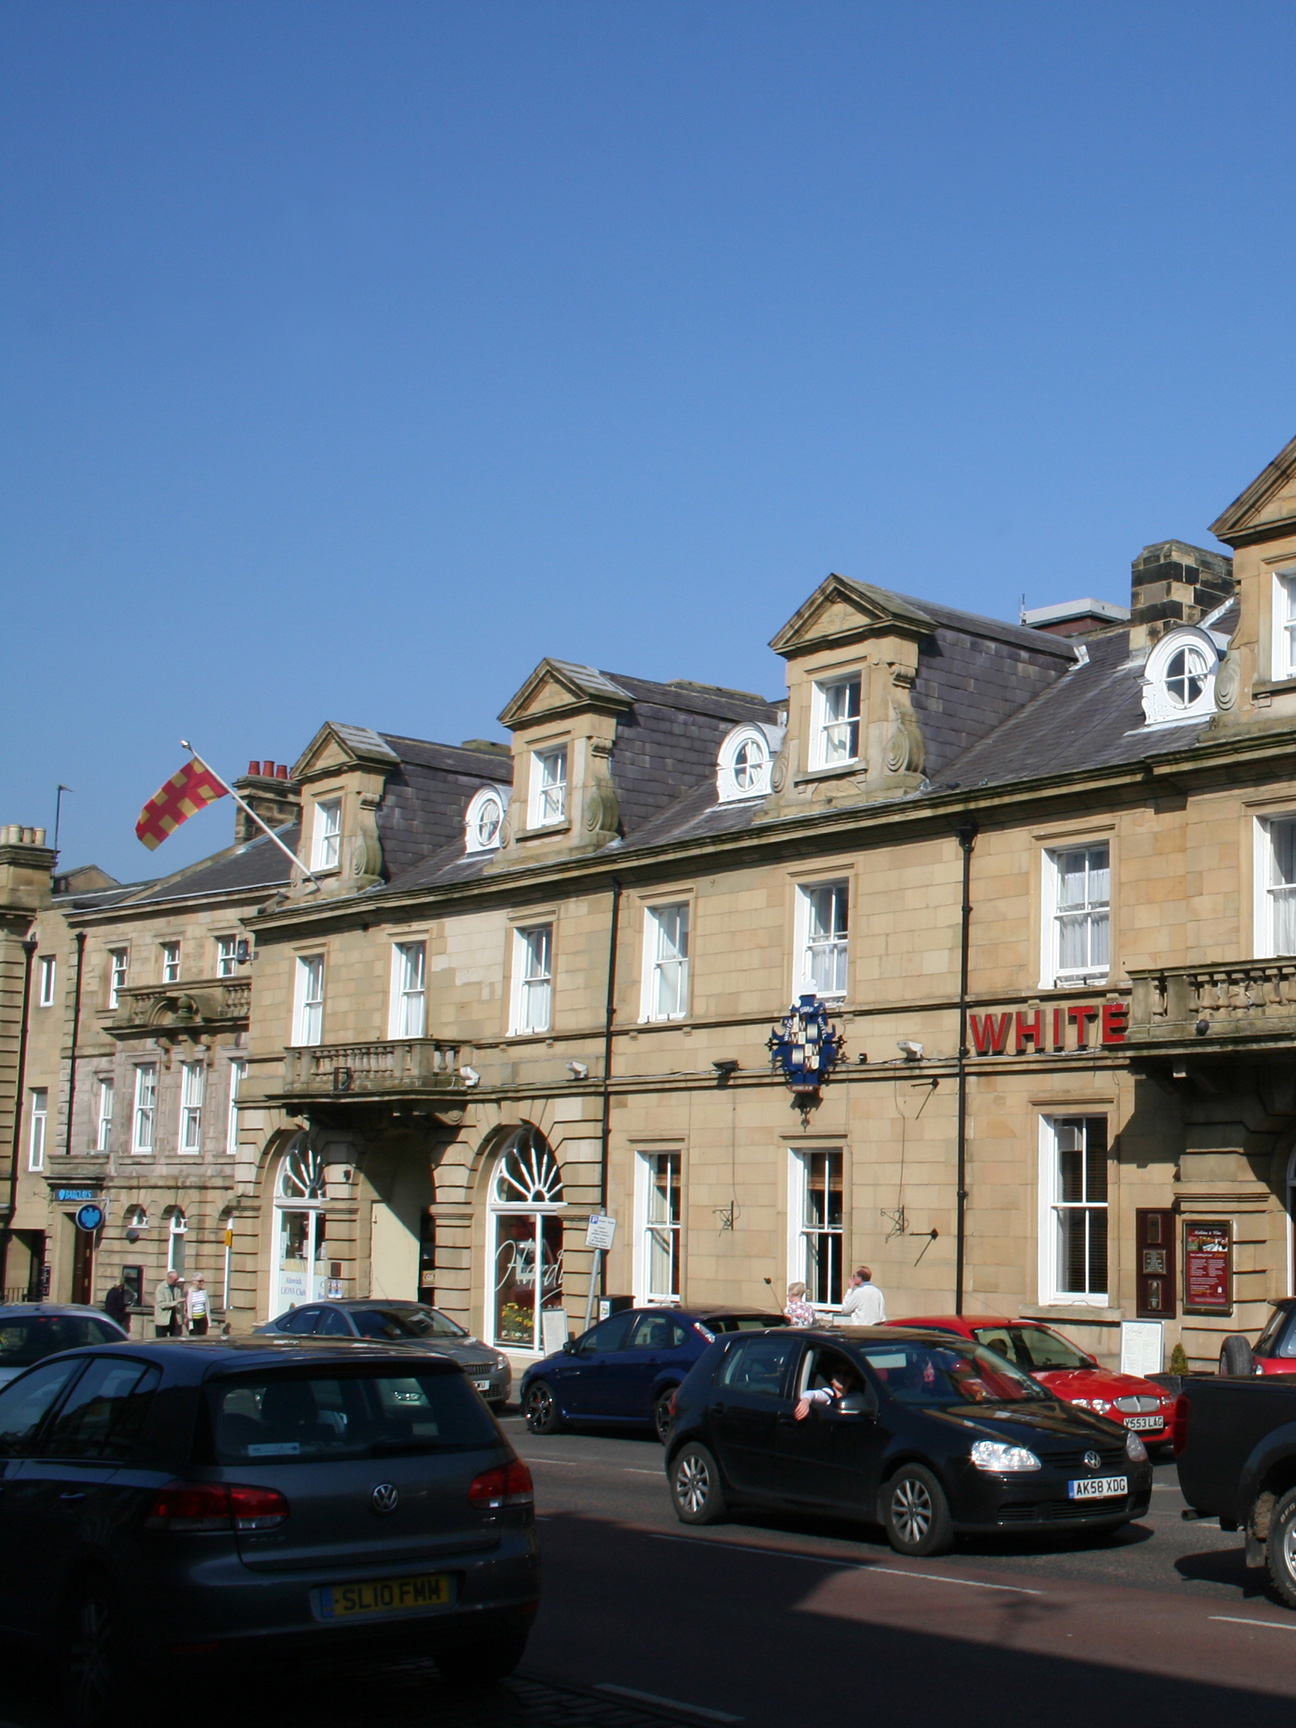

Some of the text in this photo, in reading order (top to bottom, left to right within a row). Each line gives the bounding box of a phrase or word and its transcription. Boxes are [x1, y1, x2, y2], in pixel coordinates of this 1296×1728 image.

[783, 1019, 793, 1041] WHITE
[969, 1003, 1128, 1053] WHITE
[1076, 1478, 1126, 1496] AK58 XDG
[342, 1578, 441, 1611] SL10 FMM
